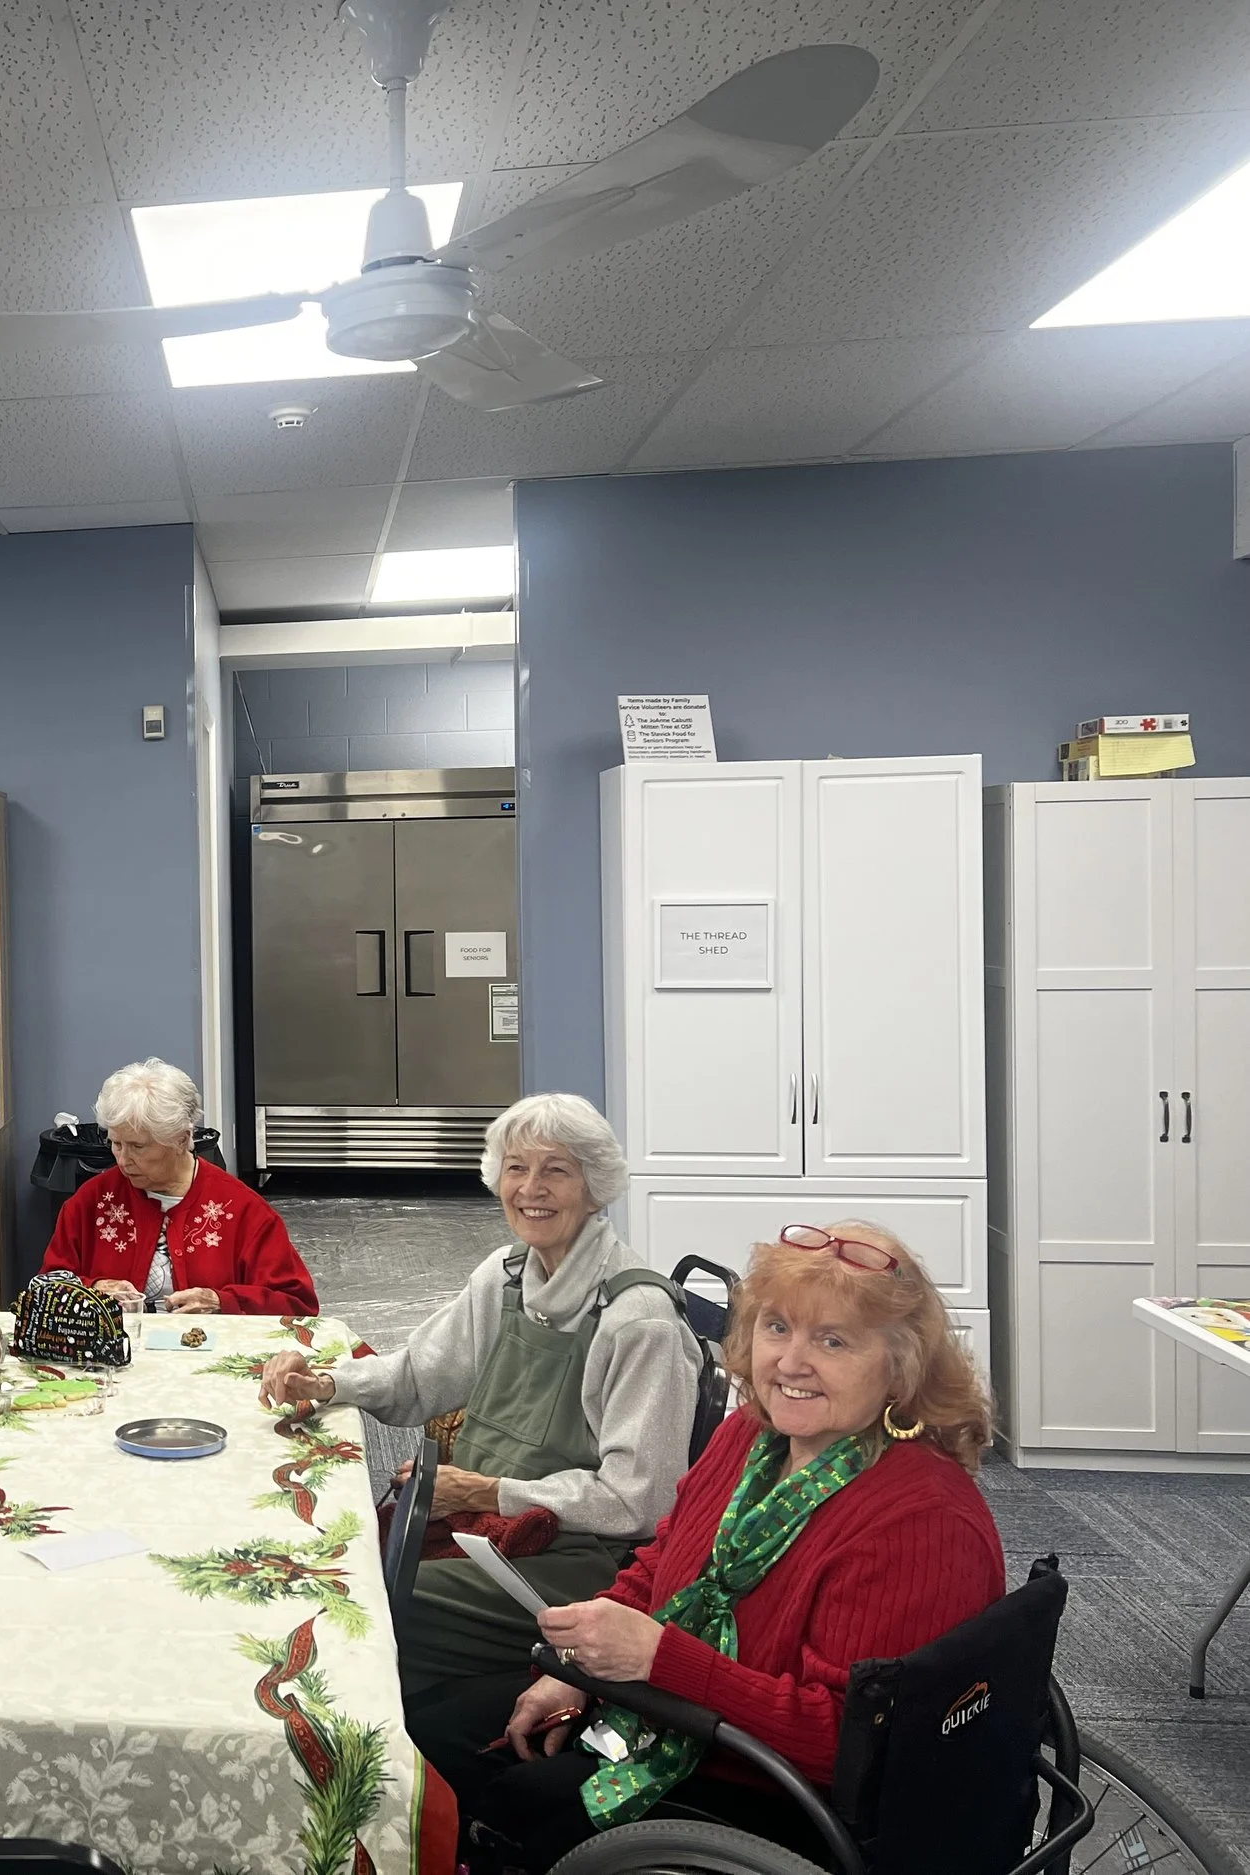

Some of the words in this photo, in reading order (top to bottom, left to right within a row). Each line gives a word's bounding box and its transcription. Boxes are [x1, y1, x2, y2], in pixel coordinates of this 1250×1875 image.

[680, 931, 701, 940] THE
[703, 931, 748, 940] THREAD
[698, 946, 729, 955] SHED
[941, 1693, 992, 1735] QUICKIE
